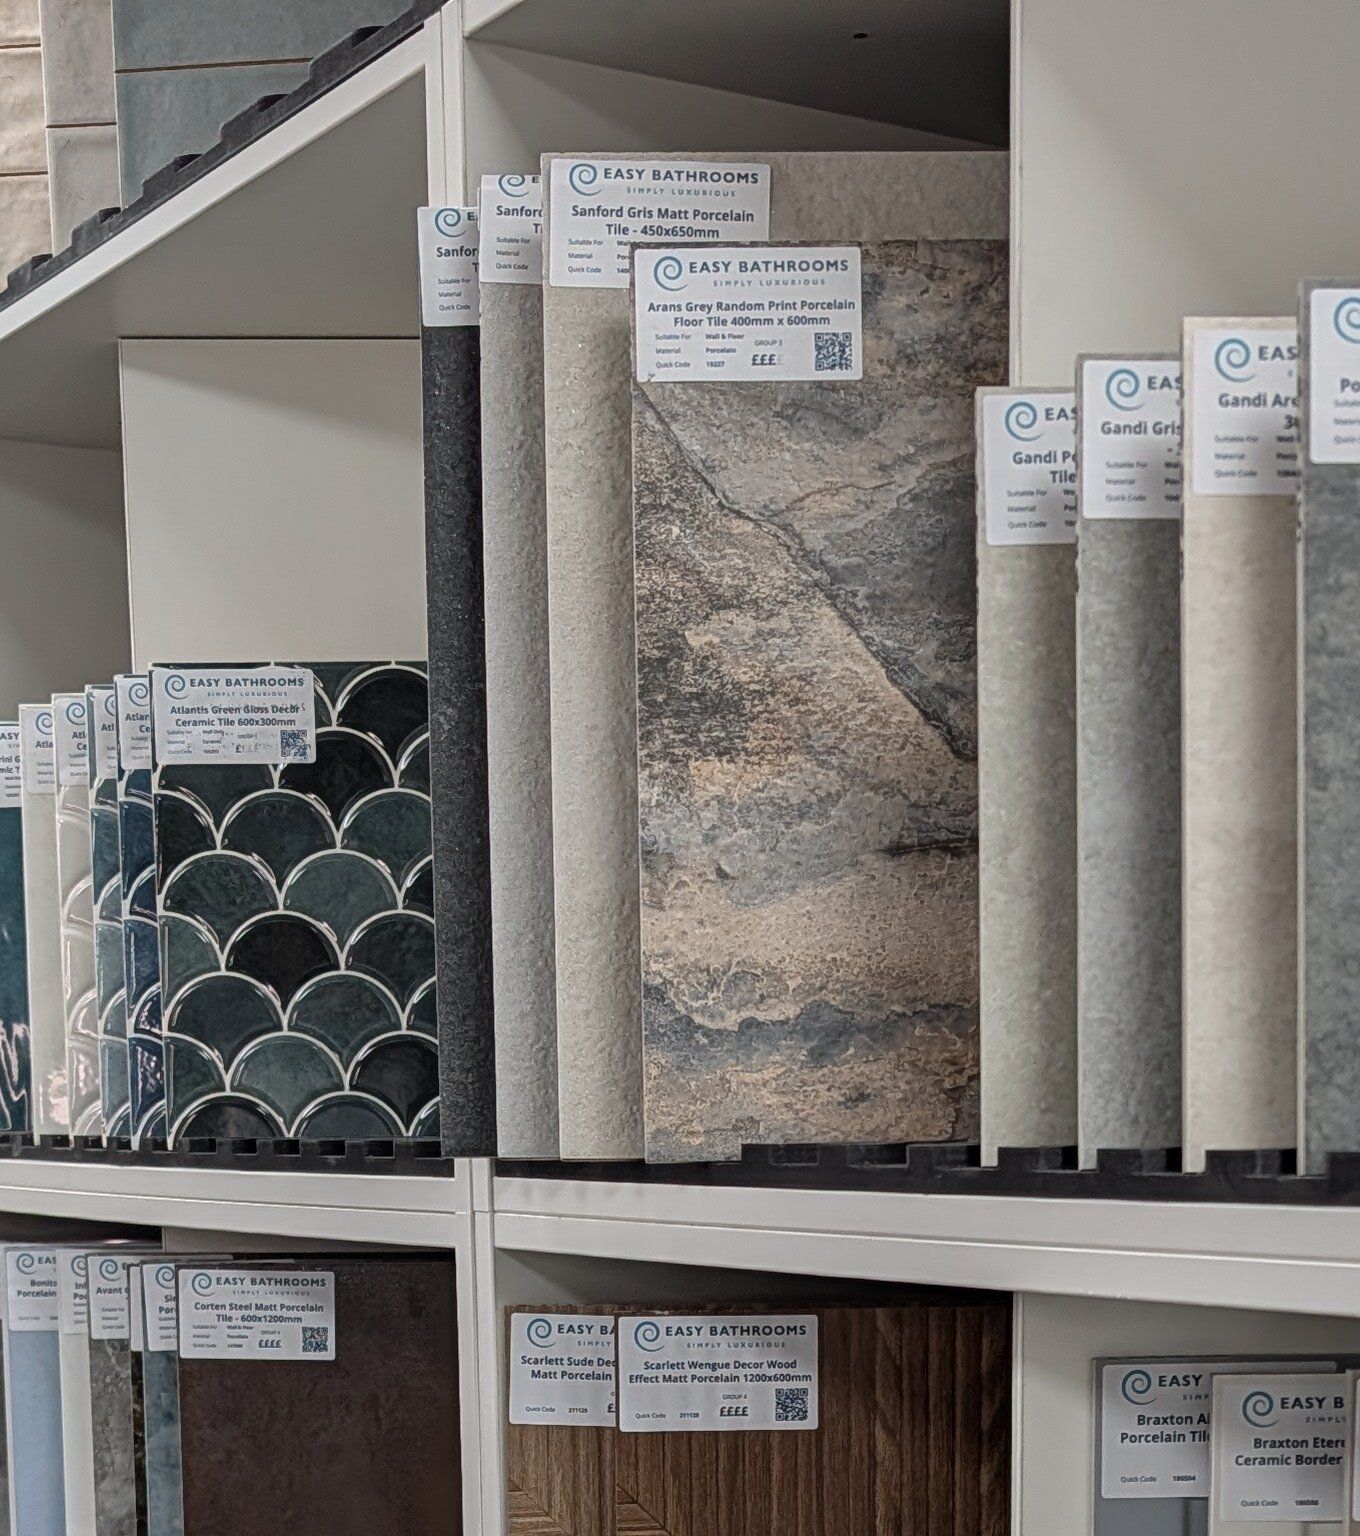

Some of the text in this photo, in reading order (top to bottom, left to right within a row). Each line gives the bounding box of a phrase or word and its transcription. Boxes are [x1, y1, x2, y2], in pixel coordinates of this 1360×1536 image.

[604, 168, 759, 184] EASY BATHROOMS
[672, 189, 736, 197] LUXURIOUS
[572, 205, 754, 222] Sanford Gris Matt Porcelain
[606, 224, 719, 238] Tile 450x650mm
[437, 246, 479, 257] Sanfor
[689, 260, 848, 273] EASY BATHROOMS
[648, 300, 855, 314] Arans Grey Random Print Porcelain
[674, 317, 703, 327] Floor
[707, 317, 728, 326] Tile
[731, 317, 774, 326] 400mm
[787, 315, 830, 325] 600mm
[1218, 393, 1267, 407] Gandi
[1101, 421, 1148, 435] Gandi
[1012, 452, 1058, 465] Gandi
[190, 678, 304, 687] EASY BATHROOMS
[171, 705, 300, 714] Atlantis Green Gloss Decor
[176, 718, 296, 727] Ceramic Tile 600x300mm
[216, 1277, 326, 1287] EASY BATHROOMS
[194, 1302, 323, 1312] Corten Steel Matt Porcelain
[216, 1314, 302, 1323] Tile 600x1200mm
[558, 1324, 594, 1334] EASY
[666, 1325, 806, 1337] EASY BATHROOMS
[521, 1355, 564, 1366] Scarlett
[567, 1357, 594, 1366] Sude
[644, 1360, 797, 1372] Scarlett Wengue Decor Wood
[531, 1370, 612, 1381] Matt Porcelain
[629, 1374, 812, 1384] Effect Matt Porcelain 1200x600mm
[1158, 1375, 1202, 1387] EASY
[1281, 1397, 1325, 1409] EASY
[1137, 1415, 1193, 1425] Braxton
[1121, 1431, 1186, 1443] Porcelain
[1254, 1438, 1308, 1448] Braxton
[1235, 1454, 1342, 1466] Ceramic Border
